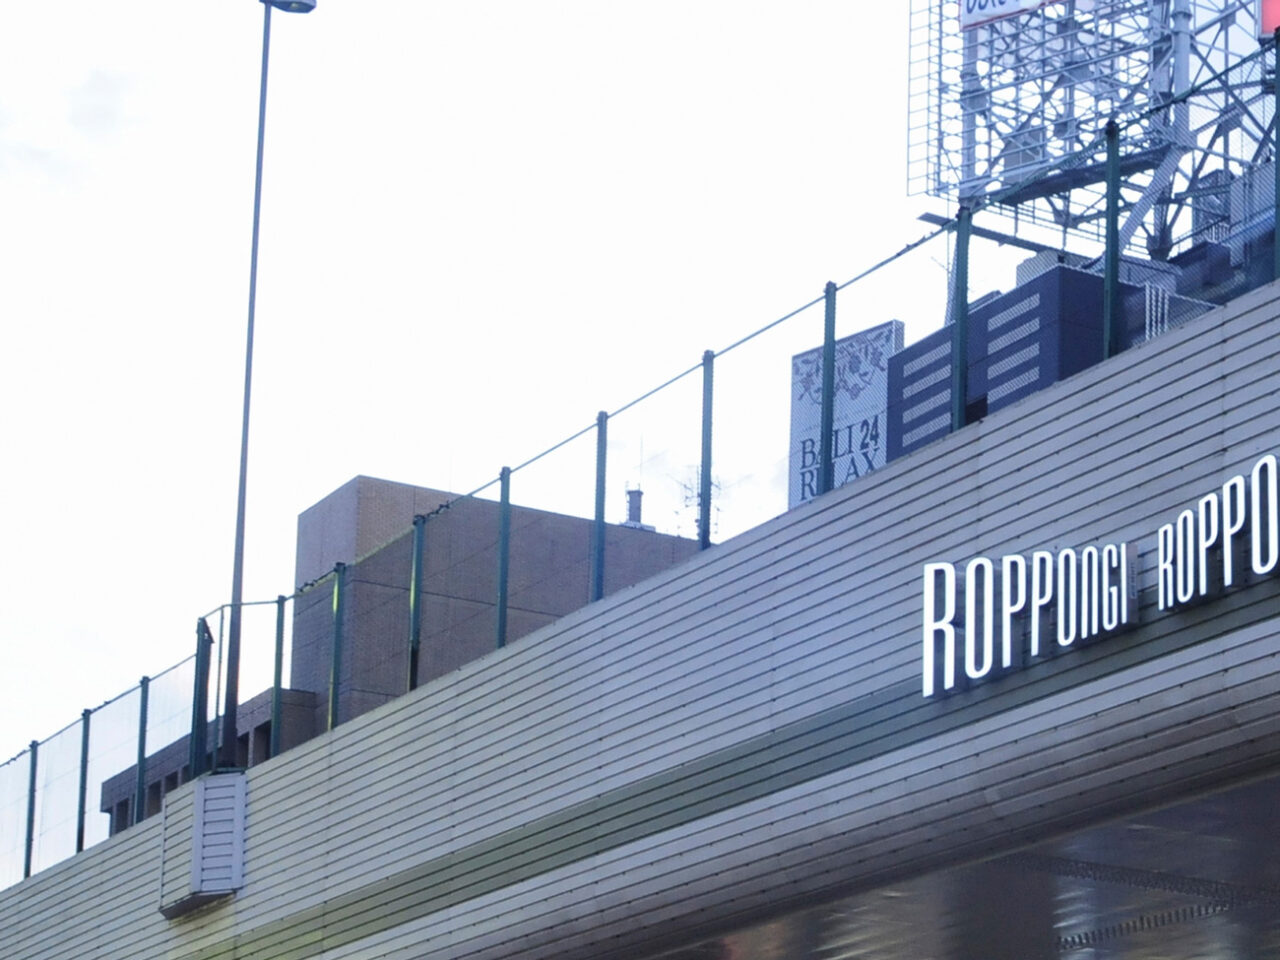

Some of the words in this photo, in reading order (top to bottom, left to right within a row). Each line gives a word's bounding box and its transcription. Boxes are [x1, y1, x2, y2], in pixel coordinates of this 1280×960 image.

[801, 425, 853, 470] BLI
[860, 414, 879, 451] 24
[922, 543, 1128, 698] ROPPONGI
